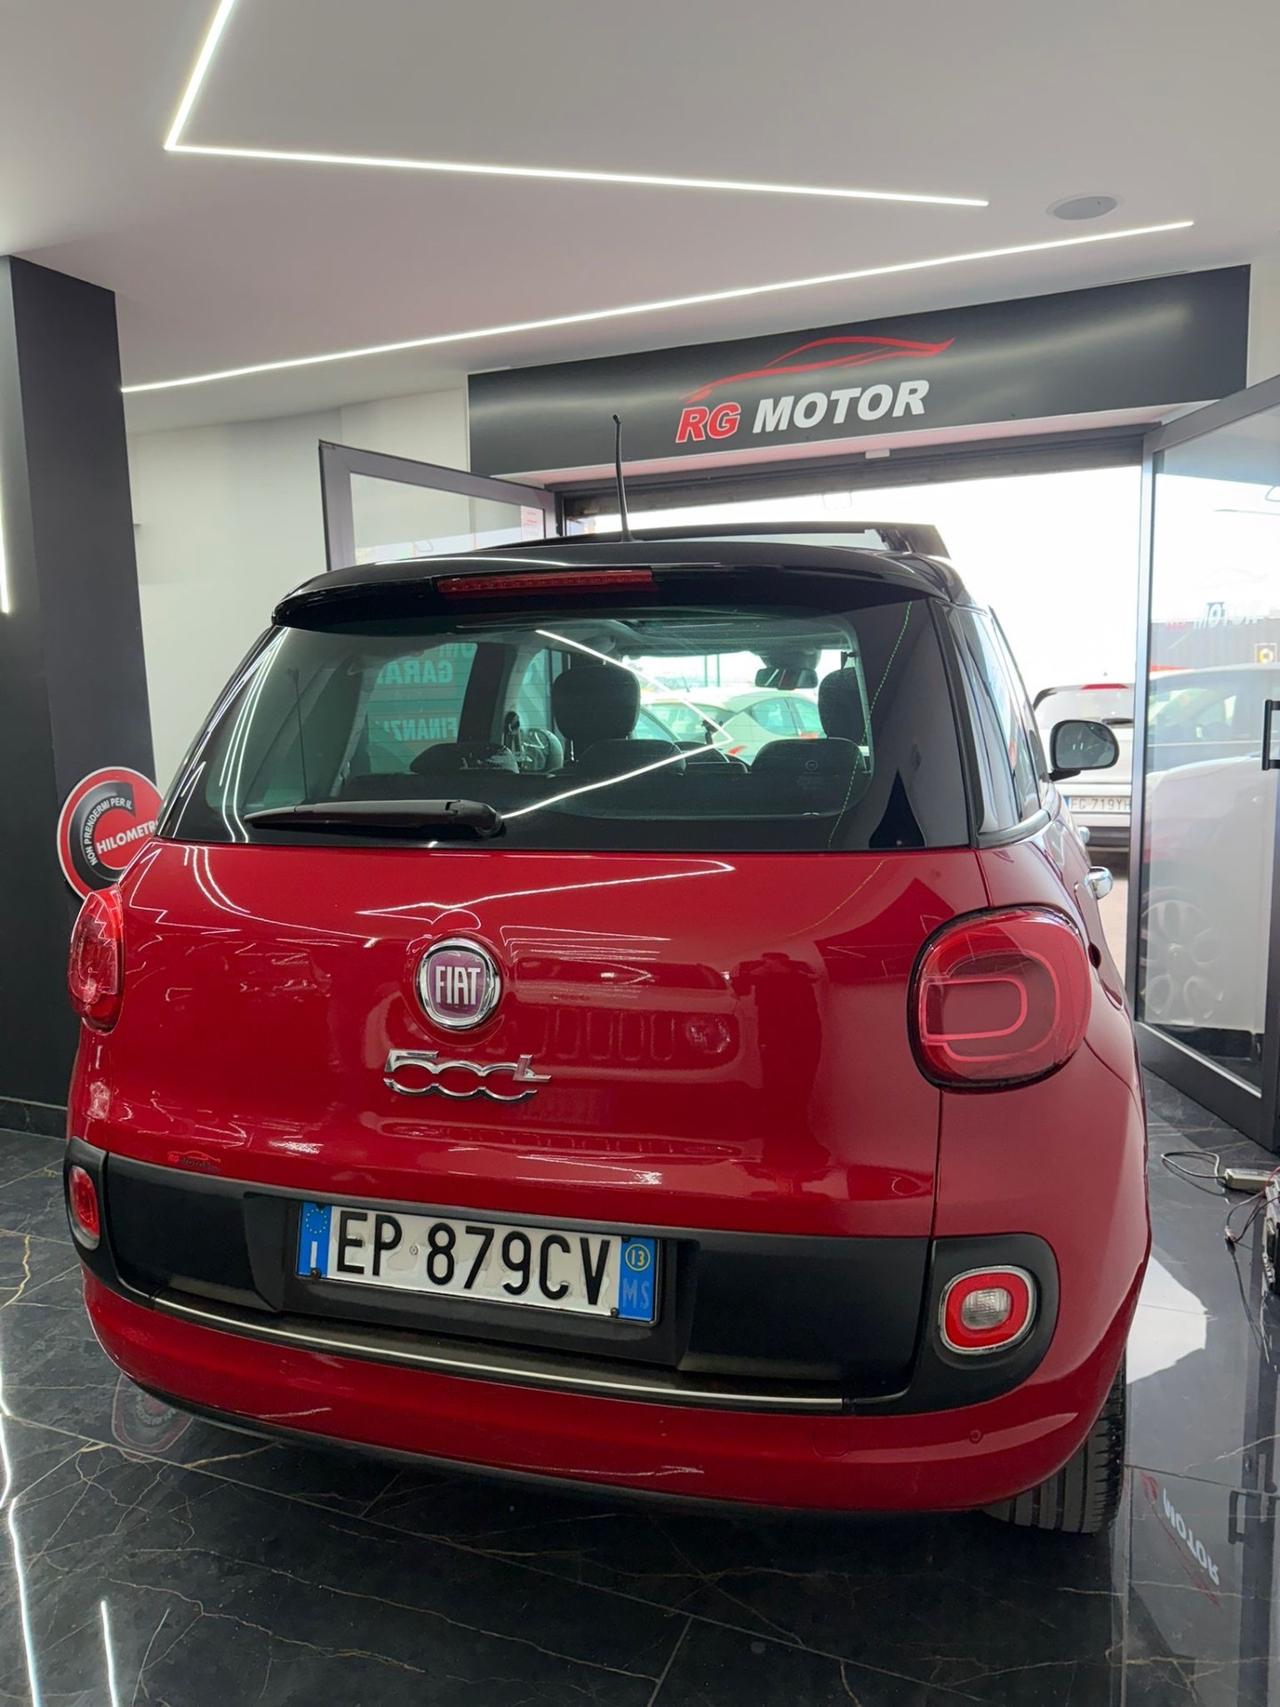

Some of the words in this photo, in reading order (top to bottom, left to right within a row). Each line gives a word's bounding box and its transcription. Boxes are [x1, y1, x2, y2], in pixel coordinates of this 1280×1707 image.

[675, 401, 742, 443] RG
[752, 379, 930, 434] MOTOR
[110, 796, 126, 808] PER
[125, 799, 134, 810] IL
[84, 799, 110, 840] PRENDERMI
[84, 840, 99, 866] NON
[435, 965, 481, 1006] FIAT
[383, 1049, 552, 1101] 500L
[309, 1240, 318, 1268] I
[337, 1209, 403, 1277] EP
[426, 1221, 611, 1306] 879CV
[631, 1248, 645, 1267] 13
[622, 1277, 650, 1310] MS
